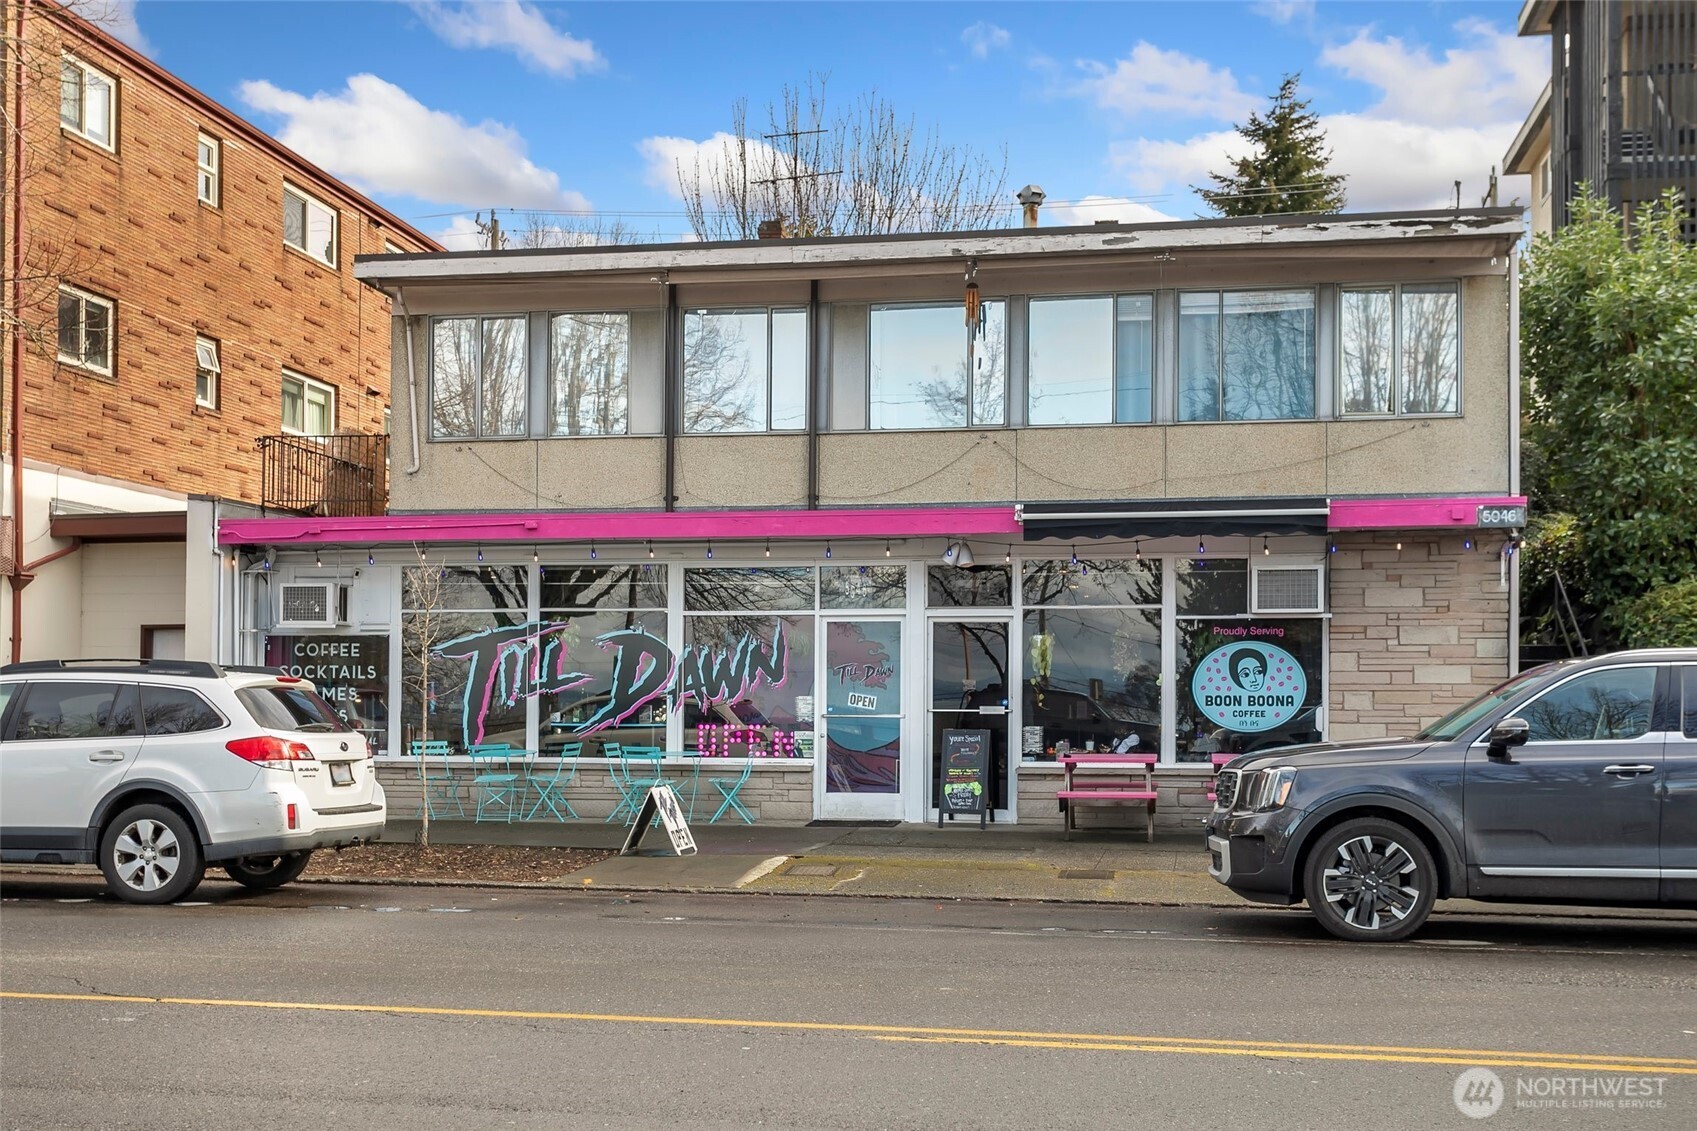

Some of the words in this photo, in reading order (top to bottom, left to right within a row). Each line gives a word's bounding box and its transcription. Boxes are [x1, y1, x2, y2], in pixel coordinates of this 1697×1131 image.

[1482, 510, 1516, 523] 5046
[1213, 626, 1248, 637] Proudly
[1249, 626, 1285, 637] Serving
[294, 643, 360, 657] COFFEE
[573, 617, 790, 739] DAWN
[849, 693, 876, 709] OPEN
[1205, 695, 1243, 707] BOON
[1247, 695, 1295, 707] BOONA
[1232, 710, 1266, 718] COFFEE
[697, 724, 795, 757] OPEN
